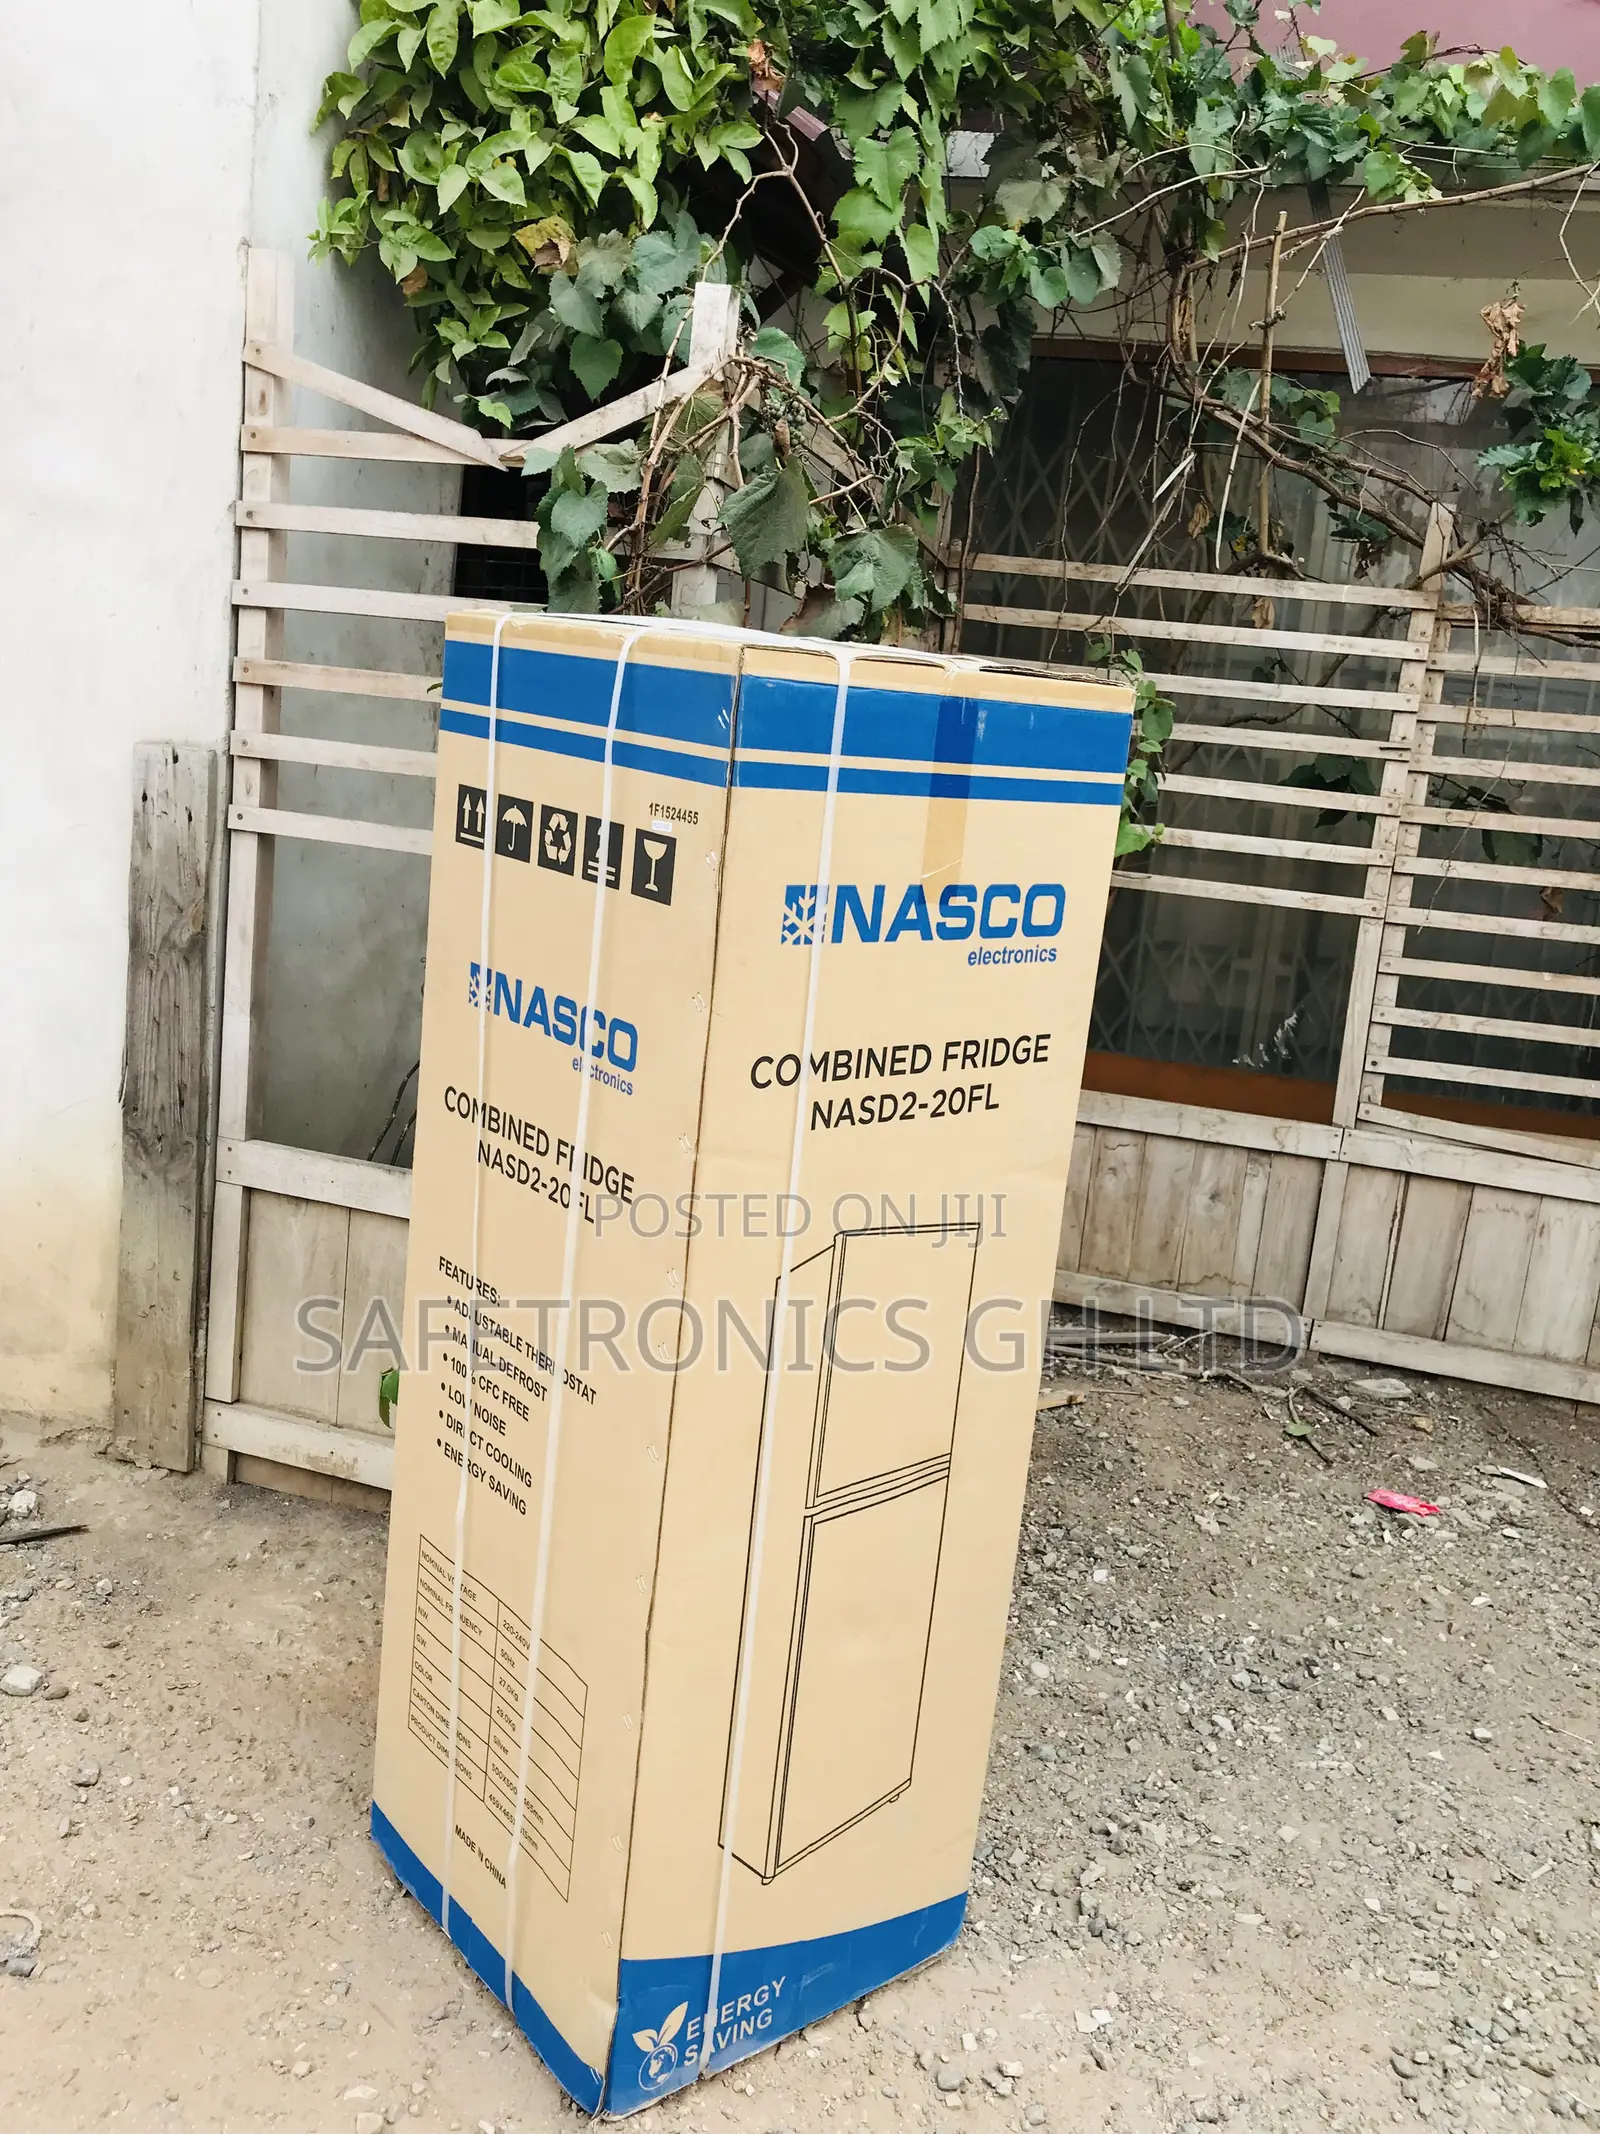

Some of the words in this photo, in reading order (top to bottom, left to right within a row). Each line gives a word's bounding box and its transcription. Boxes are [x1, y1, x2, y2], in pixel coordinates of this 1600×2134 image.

[649, 802, 699, 825] 1F1524455
[831, 884, 1066, 943] NASCO
[968, 944, 1057, 966] electronics
[493, 971, 638, 1073] NASCO
[572, 1056, 633, 1096] elctronics
[750, 1043, 932, 1089] COMBINED
[942, 1034, 1051, 1072] FRIDGE
[444, 1086, 550, 1157] COMBINED
[810, 1083, 999, 1131] NASD2-20FL
[439, 1256, 500, 1307] FEATURES:
[454, 1299, 523, 1353] ADUSTABLE
[479, 1375, 500, 1400] CFC
[502, 1390, 529, 1422] FREE
[499, 1356, 547, 1402] DEFROST
[474, 1402, 506, 1436] NOISE
[446, 1413, 484, 1450] DIRCT
[486, 1442, 532, 1488] COOLING
[488, 1475, 527, 1515] SAVING
[455, 1825, 476, 1854] MADE
[485, 1857, 507, 1890] CHINA
